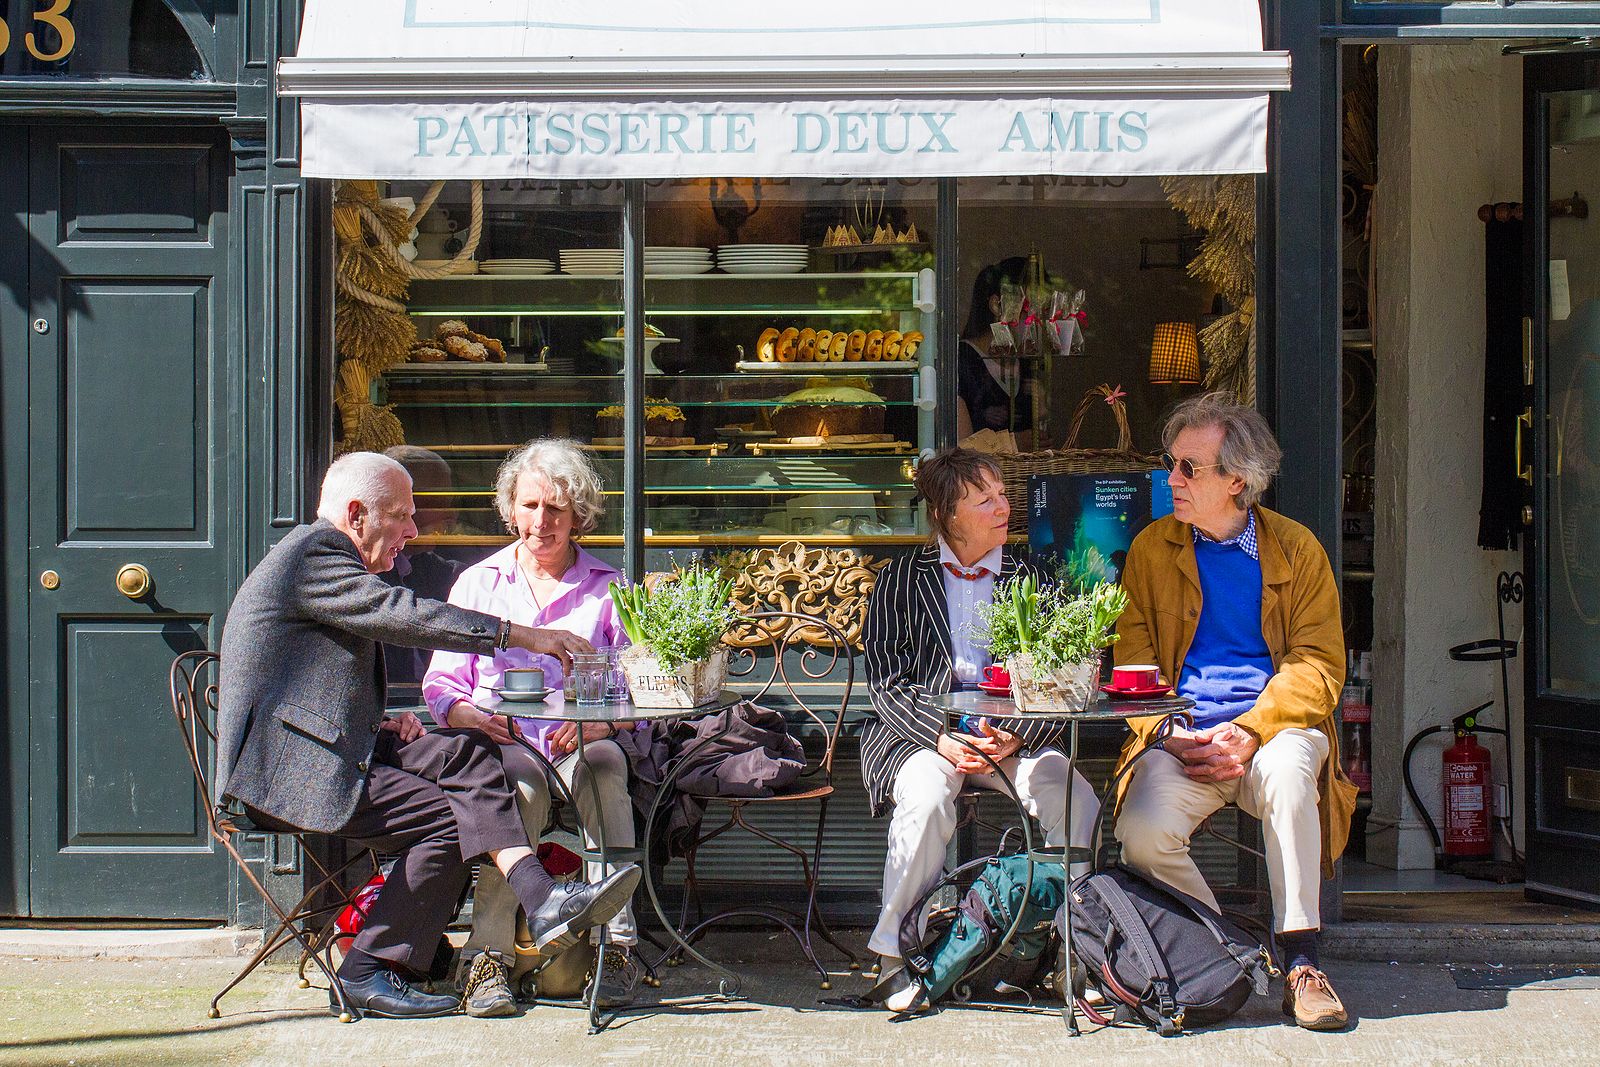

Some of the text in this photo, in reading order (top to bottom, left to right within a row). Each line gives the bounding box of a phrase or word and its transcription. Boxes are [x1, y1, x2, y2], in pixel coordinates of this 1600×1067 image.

[0, 0, 75, 61] 3
[413, 110, 1149, 158] PATISSERIE DEUX AMIS
[1095, 494, 1119, 502] Egypt's
